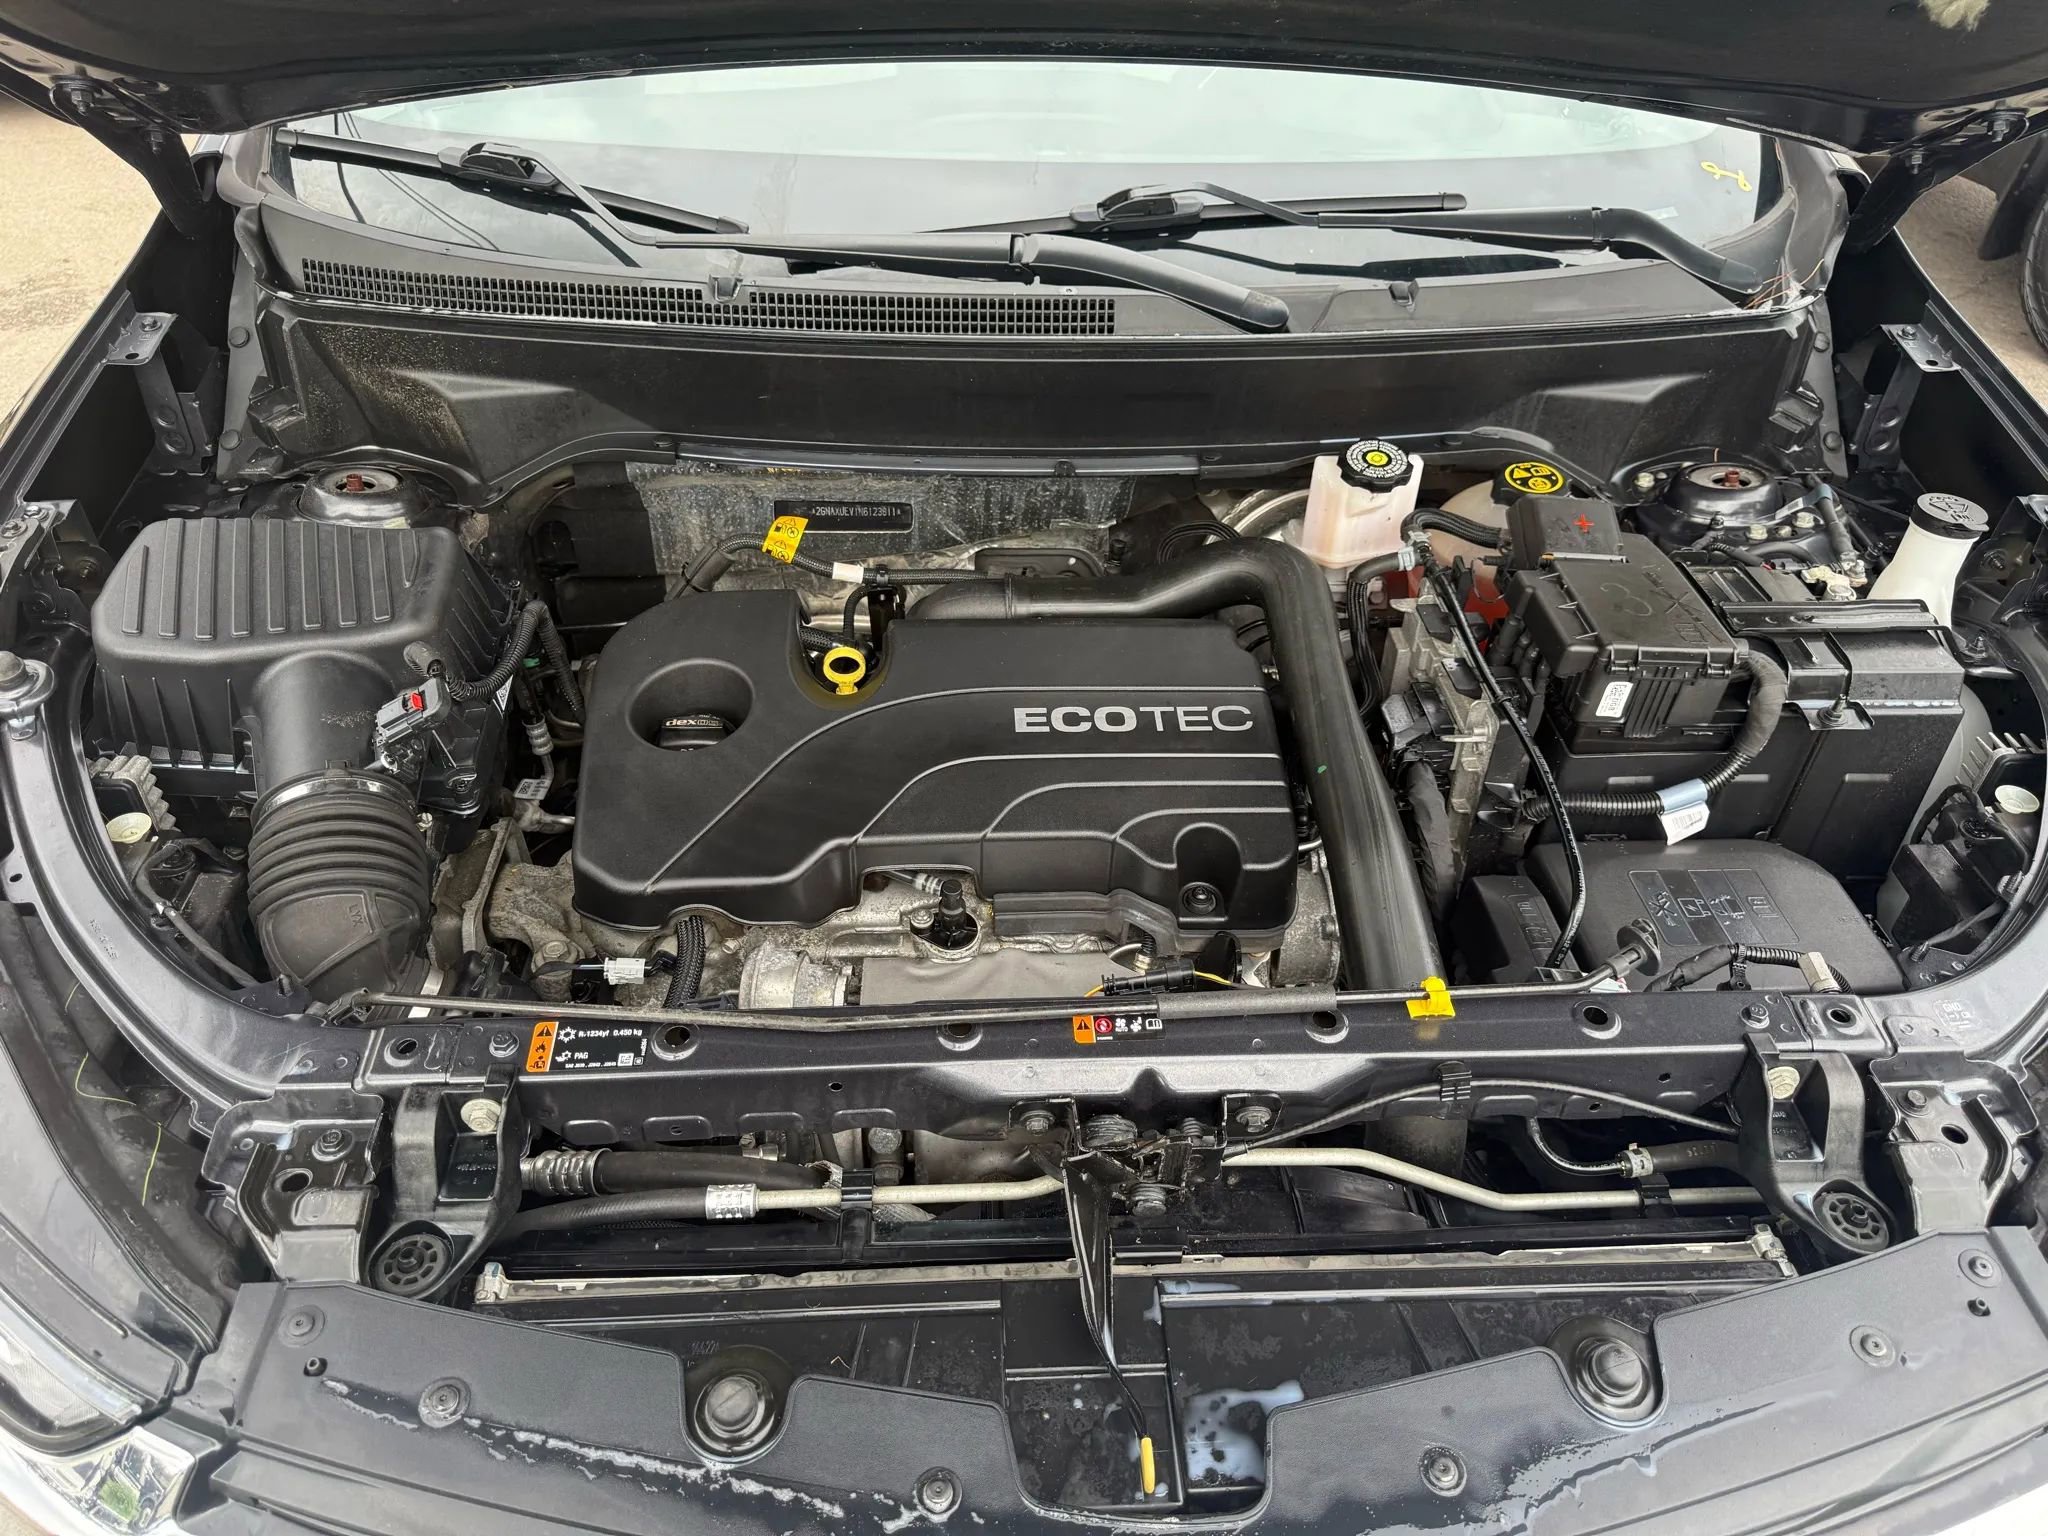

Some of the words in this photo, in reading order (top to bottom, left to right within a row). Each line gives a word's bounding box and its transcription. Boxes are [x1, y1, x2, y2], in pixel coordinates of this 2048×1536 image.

[1013, 705, 1253, 733] ECOTEC
[613, 1029, 632, 1037] 0.450
[574, 1052, 589, 1060] PAG
